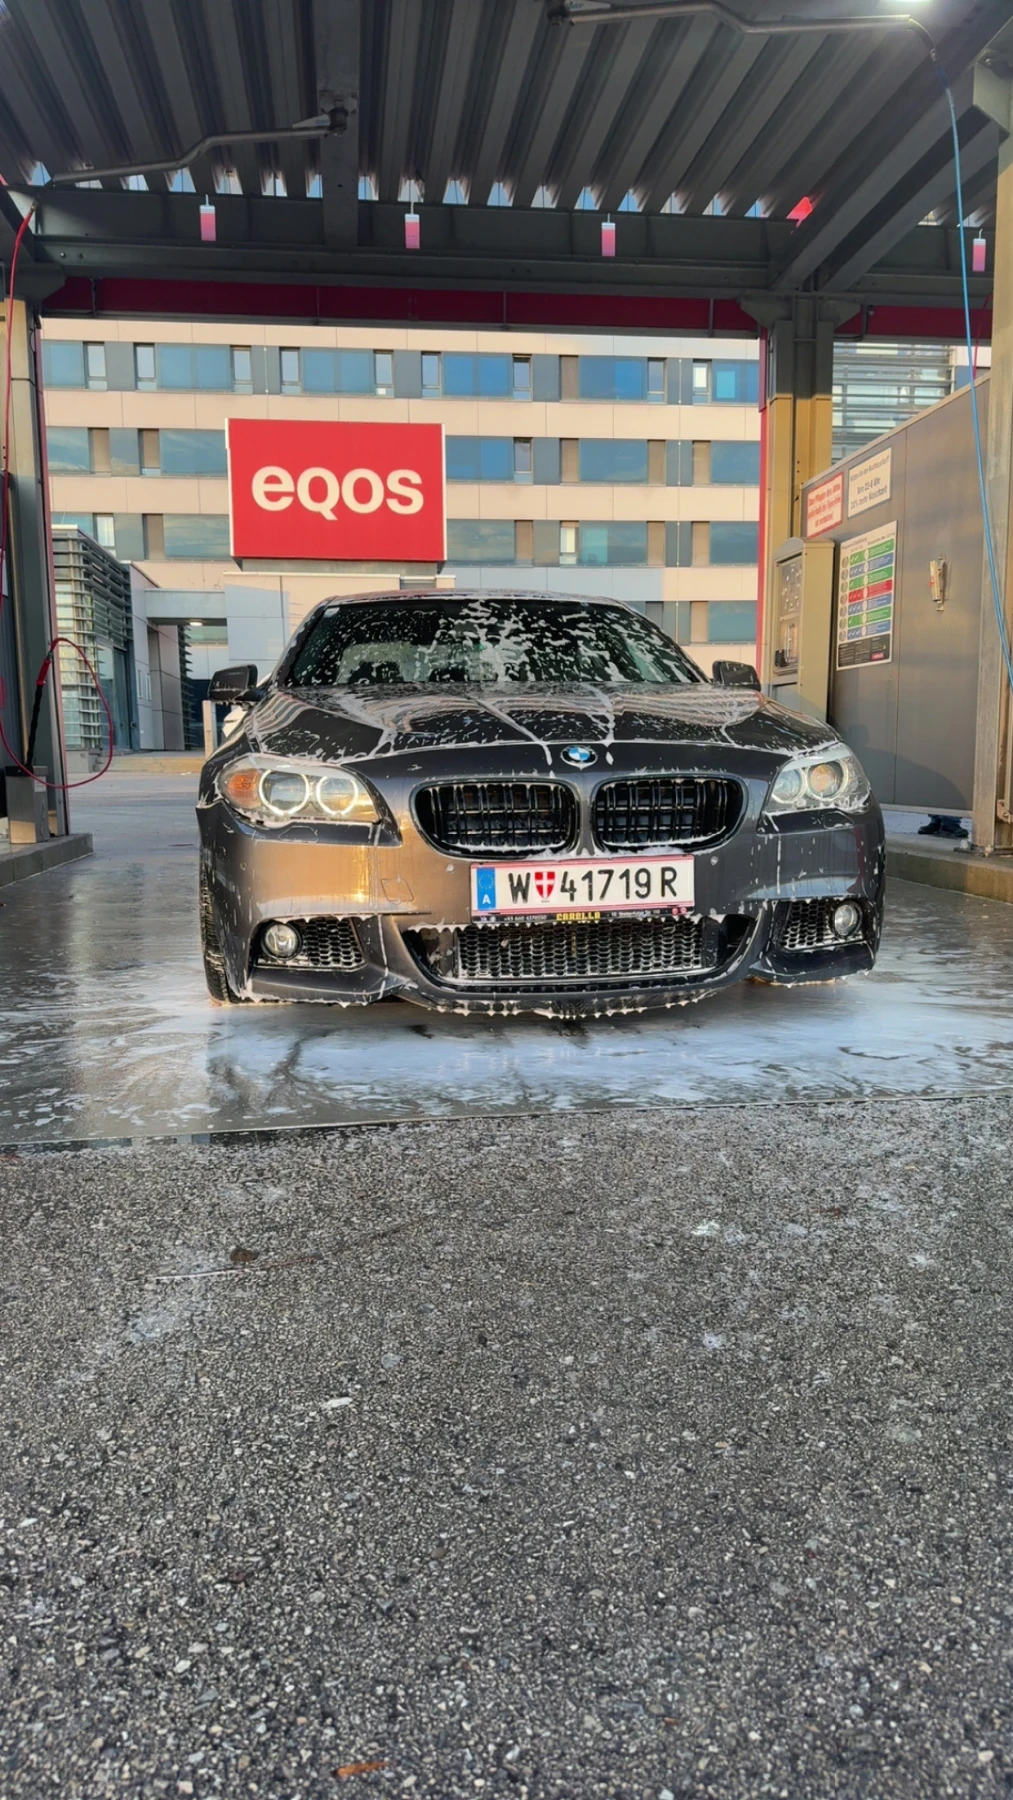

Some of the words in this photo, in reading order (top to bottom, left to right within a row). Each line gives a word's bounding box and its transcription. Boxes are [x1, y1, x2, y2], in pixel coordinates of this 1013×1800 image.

[508, 872, 530, 903] W
[560, 868, 650, 902] 41719
[661, 866, 677, 897] R
[482, 894, 492, 904] A
